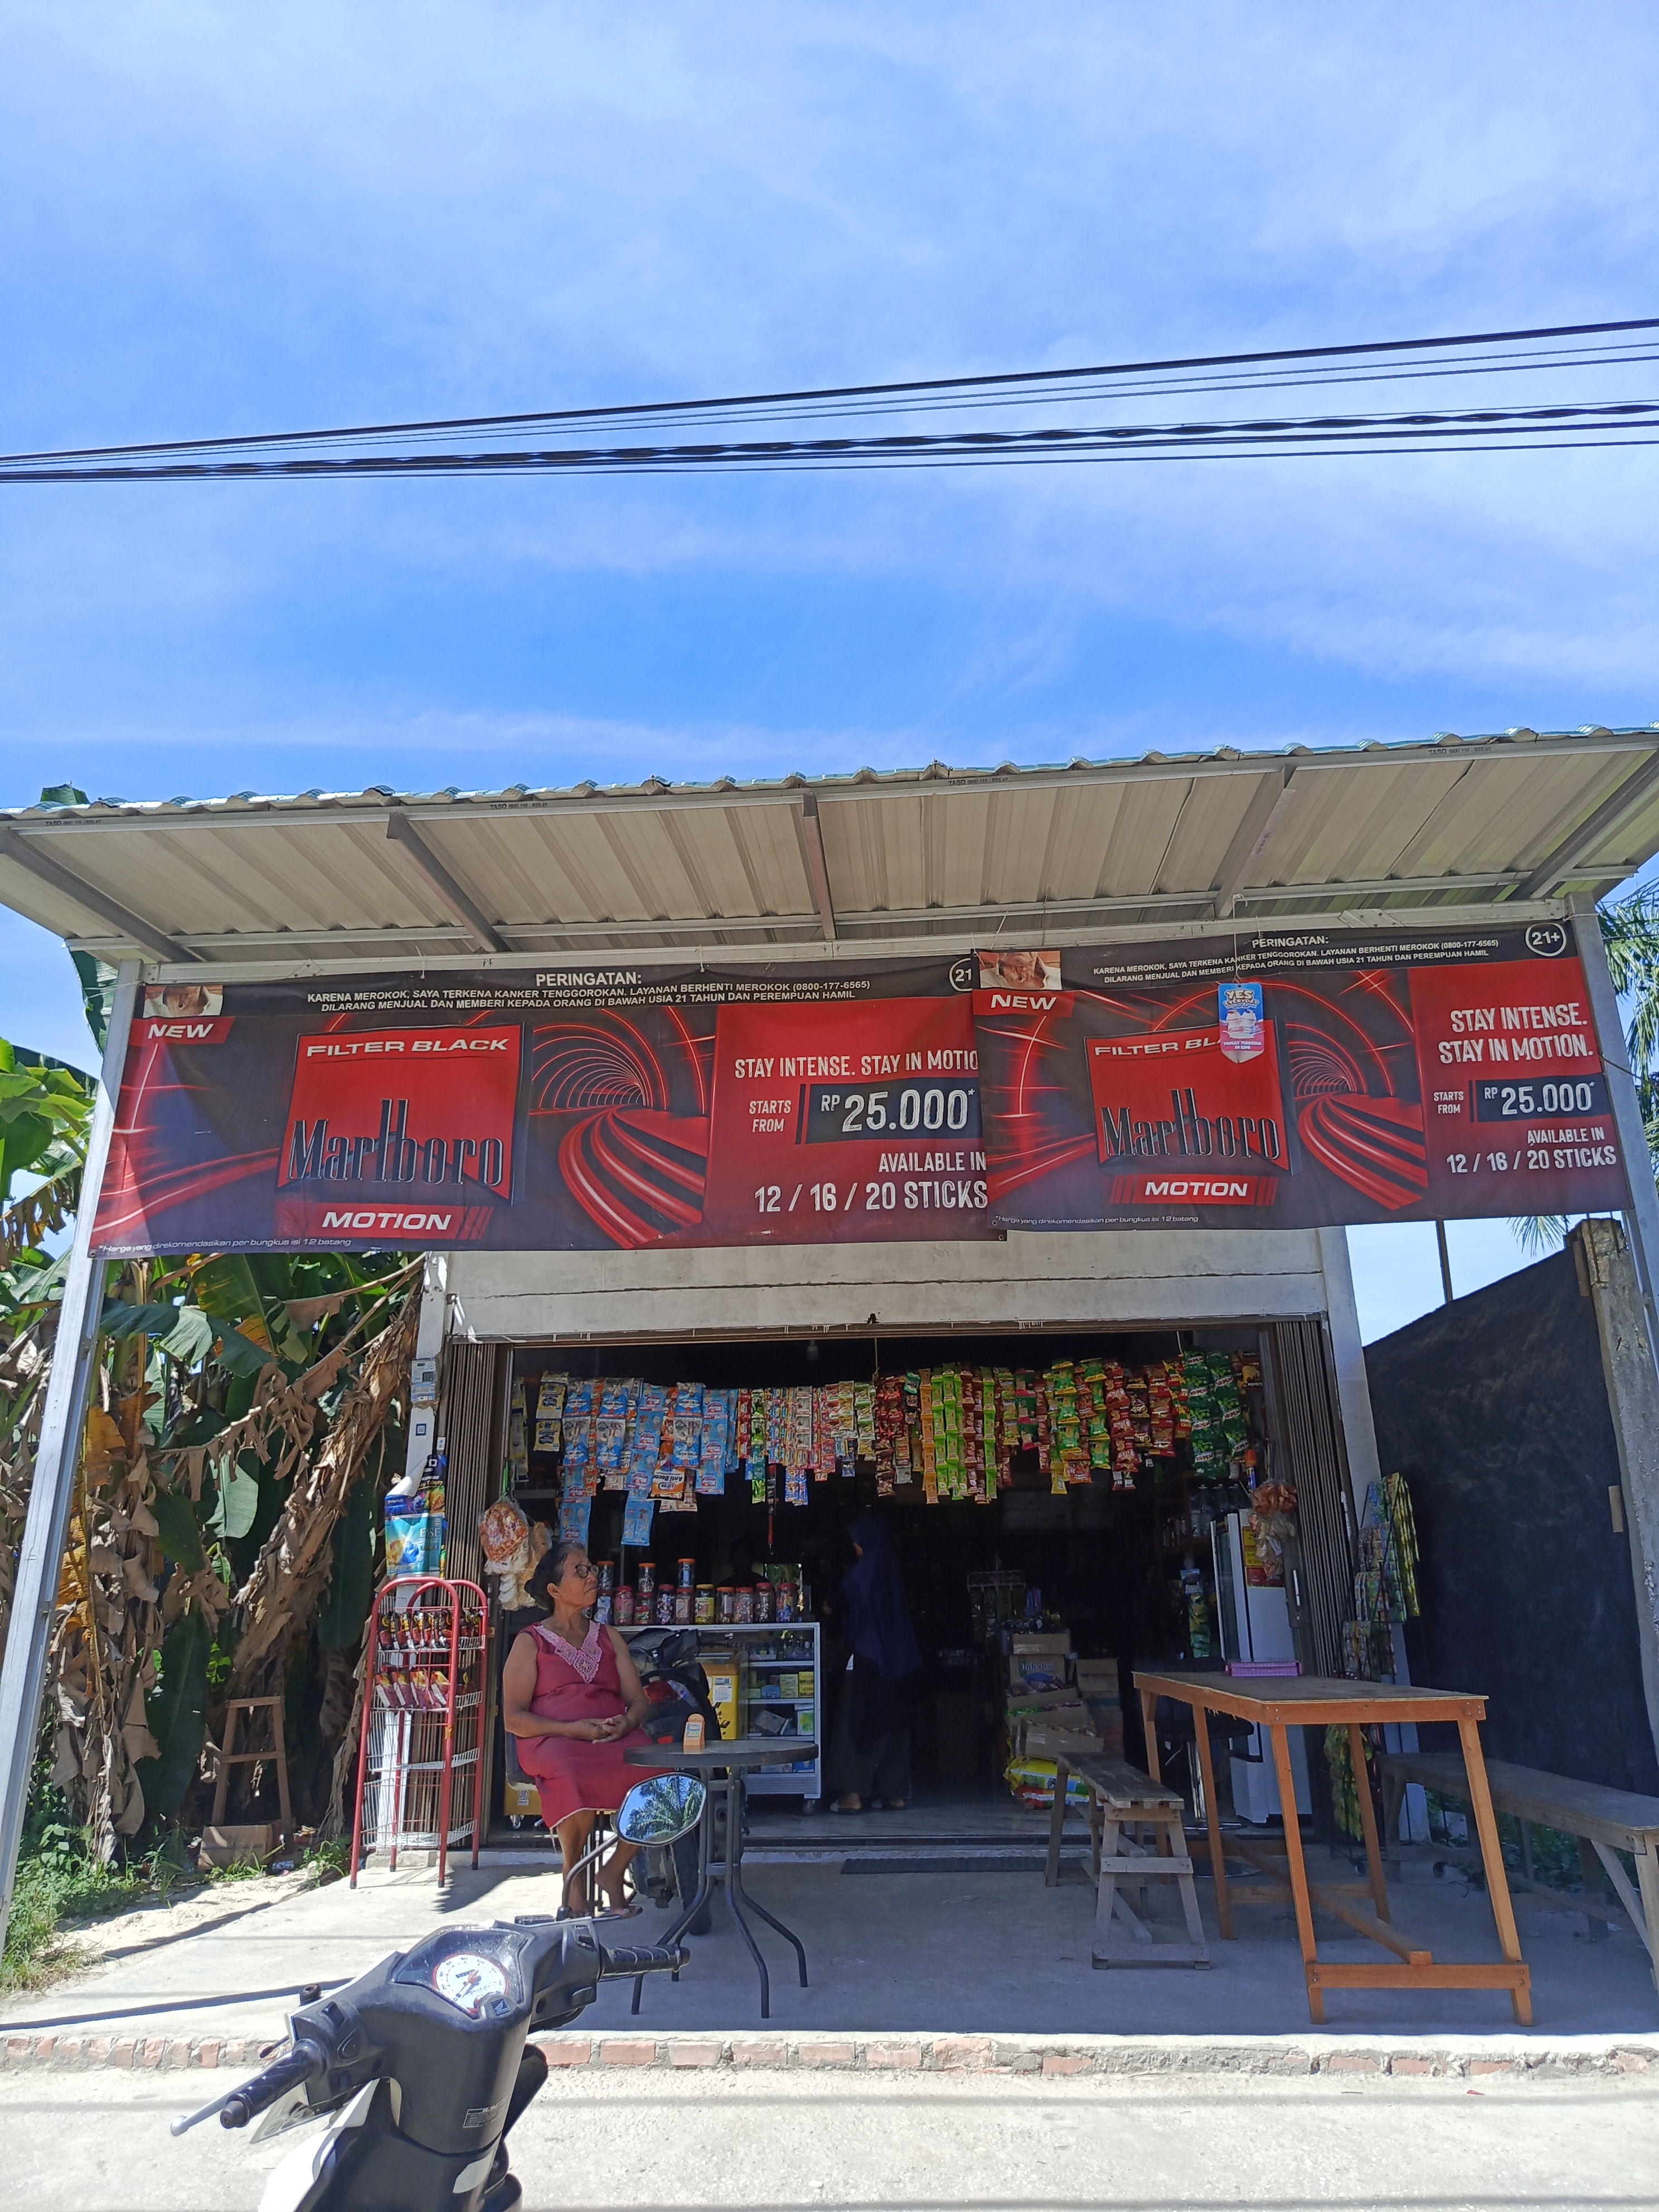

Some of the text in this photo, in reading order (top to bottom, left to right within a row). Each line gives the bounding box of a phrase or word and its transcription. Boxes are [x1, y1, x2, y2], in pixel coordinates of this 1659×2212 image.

[1251, 936, 1329, 948] PERINGATAN:
[1531, 932, 1560, 945] 21+
[1094, 966, 1126, 975] KARENA
[1127, 963, 1167, 973] MEROKOK,
[1189, 959, 1223, 968] TERKENA
[1224, 954, 1255, 964] KANKER
[1257, 951, 1319, 960] TENGGOROKAN.
[1321, 948, 1357, 957] LAYANAN
[1359, 945, 1398, 954] BERHENTI
[1399, 942, 1439, 951] MEROKOK
[1440, 939, 1498, 950] (0800-177-6565)
[1104, 974, 1143, 983] DILARANG
[1144, 972, 1180, 981] MENJUAL
[1199, 966, 1234, 976] MEMBERI
[1236, 962, 1266, 971] KEPADA
[1267, 959, 1294, 967] ORANG
[1366, 955, 1393, 963] TAHUN
[1413, 952, 1462, 961] PEREMPUAN
[1464, 950, 1489, 958] HAMIL
[536, 972, 642, 986] PERINGATAN:
[955, 968, 972, 982] 21
[308, 980, 870, 1002] KARENA MEROKOK, SAYA TERKENA KANKER TENGGOROKAN. LAYANAN BERHENTI MEROKOK (0800-177-6565)
[1226, 990, 1253, 1000] YES
[321, 990, 855, 1012] DILARANG MENJUAL DAN MEMBERI KEPADA ORANG DI BAWAH USIA 21 TAHUN DAN PEREMPUAN HAMIL
[991, 994, 1057, 1010] NEW
[1451, 1003, 1588, 1032] STAY INTENSE.
[148, 1023, 214, 1039] NEW
[307, 1037, 510, 1056] FILTER BLACK
[1094, 1041, 1179, 1057] FILTER
[1438, 1034, 1593, 1064] STAY IN MOTION.
[735, 1050, 978, 1079] STAY INTENSE. STAY IN MOTIO
[1433, 1090, 1464, 1102] STARTS
[1484, 1086, 1498, 1099] RP
[749, 1099, 792, 1114] STARTS
[821, 1094, 841, 1112] RP
[1438, 1104, 1461, 1114] FROM
[752, 1118, 785, 1133] FROM
[1100, 1088, 1280, 1161] Marlboro
[287, 1098, 503, 1186] Marlboro
[1527, 1127, 1605, 1144] AVAILABLE IN
[879, 1151, 986, 1173] AVAILABLE IN
[1446, 1145, 1617, 1173] 12 / 16 / 20 STICKS
[754, 1180, 988, 1212] 12 / 16 / 20 STICKS
[1144, 1181, 1248, 1197] MOTION
[322, 1211, 452, 1230] MOTION
[132, 1244, 152, 1253] yang
[153, 1240, 231, 1249] direkomendasikan
[250, 1239, 289, 1247] bungkus
[318, 1239, 351, 1247] batang
[420, 1527, 441, 1537] ESSE
